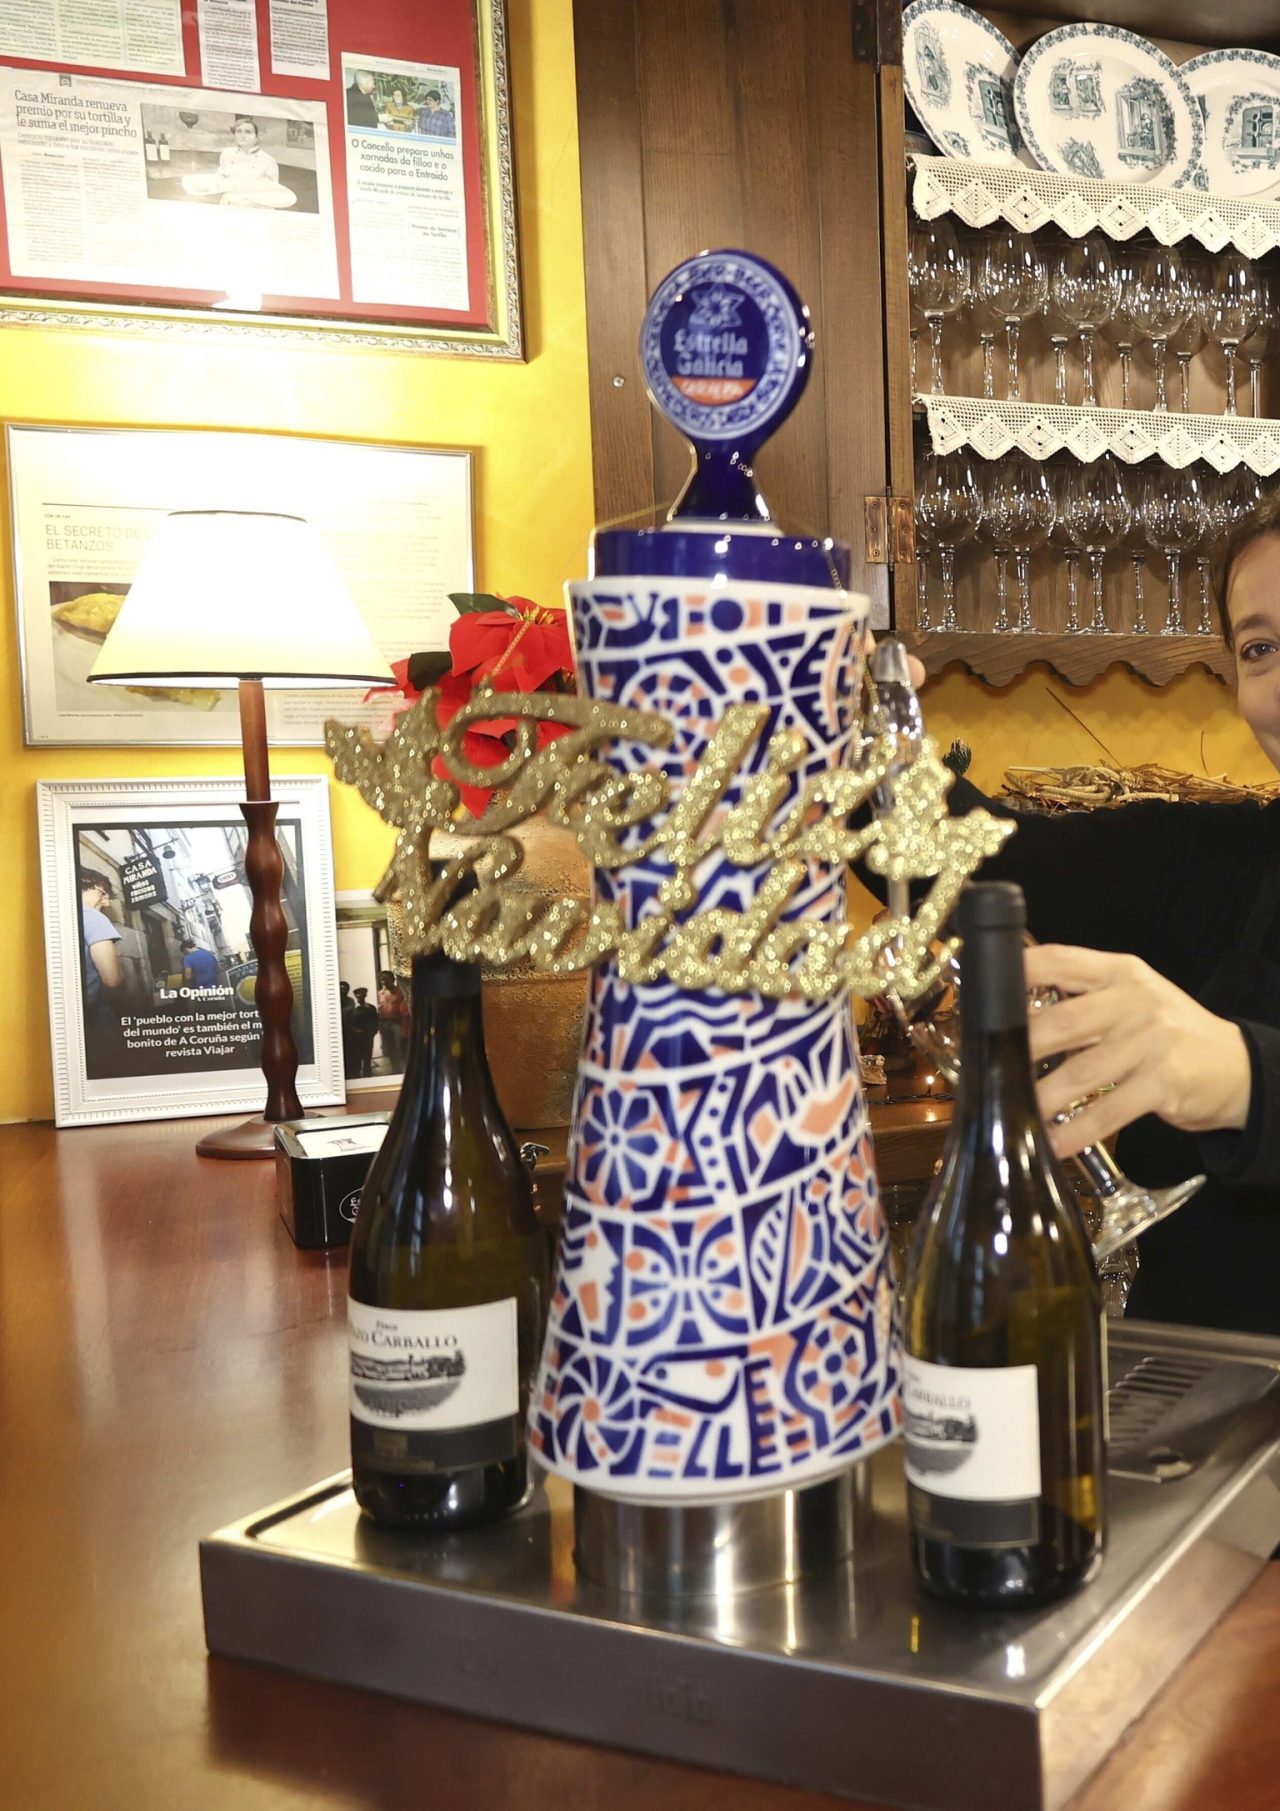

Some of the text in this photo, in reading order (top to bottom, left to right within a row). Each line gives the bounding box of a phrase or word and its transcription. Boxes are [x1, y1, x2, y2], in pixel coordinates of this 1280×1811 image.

[14, 89, 128, 112] Casa Miranda renueva
[16, 104, 131, 127] premio por su tortilla y
[28, 117, 57, 130] suma
[58, 117, 69, 131] el
[70, 120, 99, 136] mejor
[101, 122, 137, 138] pincho
[351, 138, 454, 161] O Concello prepara unhas
[359, 163, 386, 175] cocido
[387, 167, 407, 177] para
[408, 169, 414, 178] o
[360, 153, 447, 170] xornadas da filloa e o
[674, 328, 749, 356] Estrella
[676, 350, 744, 378] Galicia
[45, 523, 60, 536] EL
[63, 525, 122, 540] SECRETO
[46, 538, 113, 552] BETANZOS
[123, 867, 160, 887] MIRANDA
[125, 860, 154, 876] CASA
[377, 824, 962, 1000] Navidad
[160, 985, 234, 1000] La Opinión
[121, 1009, 260, 1027] El 'pueblo con la mejor tort
[123, 1028, 140, 1037] del
[142, 1025, 182, 1036] mundo'
[183, 1026, 195, 1034] es
[196, 1021, 239, 1033] también
[241, 1020, 251, 1030] el
[126, 1032, 260, 1049] bonito de A Coruña según
[165, 1045, 235, 1057] revista Viajar
[371, 1329, 458, 1349] CARBALLO
